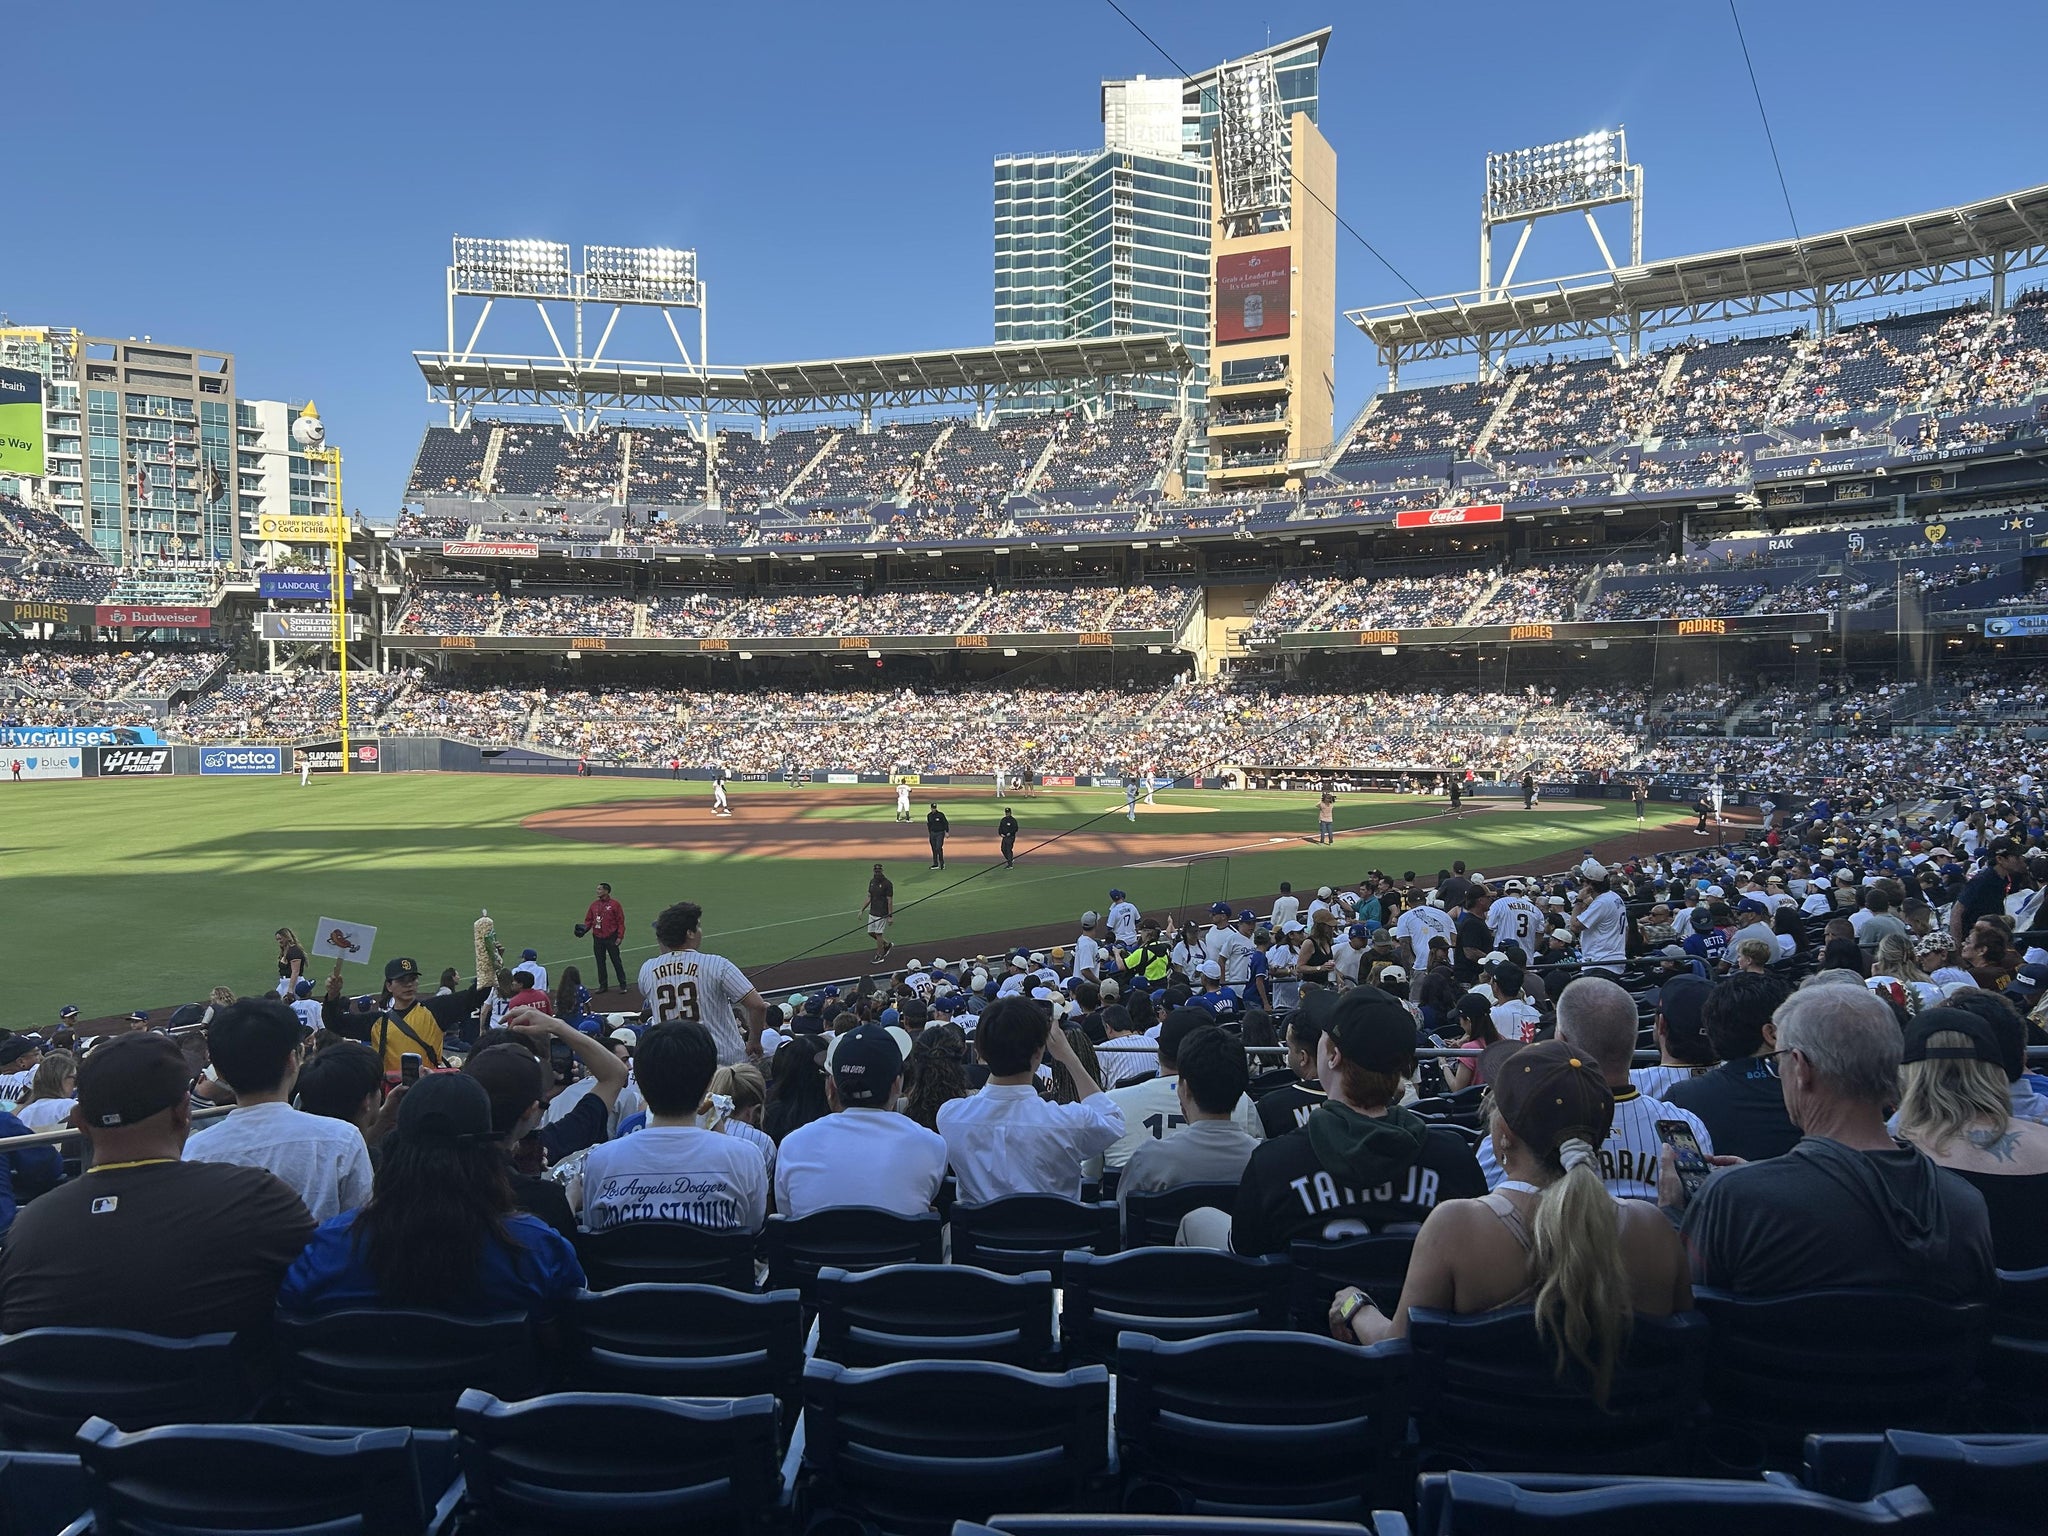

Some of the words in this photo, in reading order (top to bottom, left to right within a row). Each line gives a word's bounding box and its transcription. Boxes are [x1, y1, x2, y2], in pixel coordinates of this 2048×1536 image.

[8, 438, 32, 451] Way
[1912, 453, 1934, 462] TONY
[1938, 450, 1950, 460] 19
[1952, 446, 1985, 457] GWYNN
[1776, 467, 1804, 478] STEVE
[1808, 466, 1816, 476] 6
[1820, 462, 1855, 473] GARVEY
[1930, 528, 1940, 538] PS
[446, 543, 497, 555] Tarantino
[498, 548, 537, 556] SAUSAGES
[1768, 538, 1794, 551] RAK
[616, 547, 638, 558] 5:39
[278, 582, 323, 592] LANDCARE
[14, 604, 68, 623] PADRES
[132, 612, 198, 623] Budweiser
[290, 618, 338, 626] SINGLETON
[1678, 618, 1725, 635] PADRES
[1361, 631, 1398, 645] PADRES
[1510, 624, 1552, 640] PADRES
[440, 636, 476, 648] PADRES
[572, 638, 606, 650] PADRES
[700, 638, 728, 650] PADRES
[840, 638, 870, 649] PADRES
[956, 636, 988, 648] PADRES
[1079, 634, 1112, 645] PADRES
[42, 757, 68, 766] blue
[125, 751, 168, 764] H2O
[227, 752, 276, 767] petco
[308, 752, 324, 760] SLAP
[326, 752, 342, 760] SOME
[121, 764, 162, 772] POWER
[1545, 786, 1570, 796] petco
[1508, 902, 1535, 914] MERRILL
[1123, 915, 1131, 926] 17
[1516, 914, 1528, 938] 3
[1704, 934, 1725, 948] BETTS
[652, 962, 683, 980] TATIS
[684, 962, 699, 978] JR.
[656, 982, 700, 1021] 23
[497, 1001, 509, 1016] 17
[841, 1064, 850, 1073] SAN
[850, 1065, 866, 1074] DIEGO
[600, 1180, 620, 1200] Los
[620, 1178, 672, 1202] Angeles
[672, 1176, 728, 1200] Dodgers
[659, 1200, 737, 1228] STADIUM
